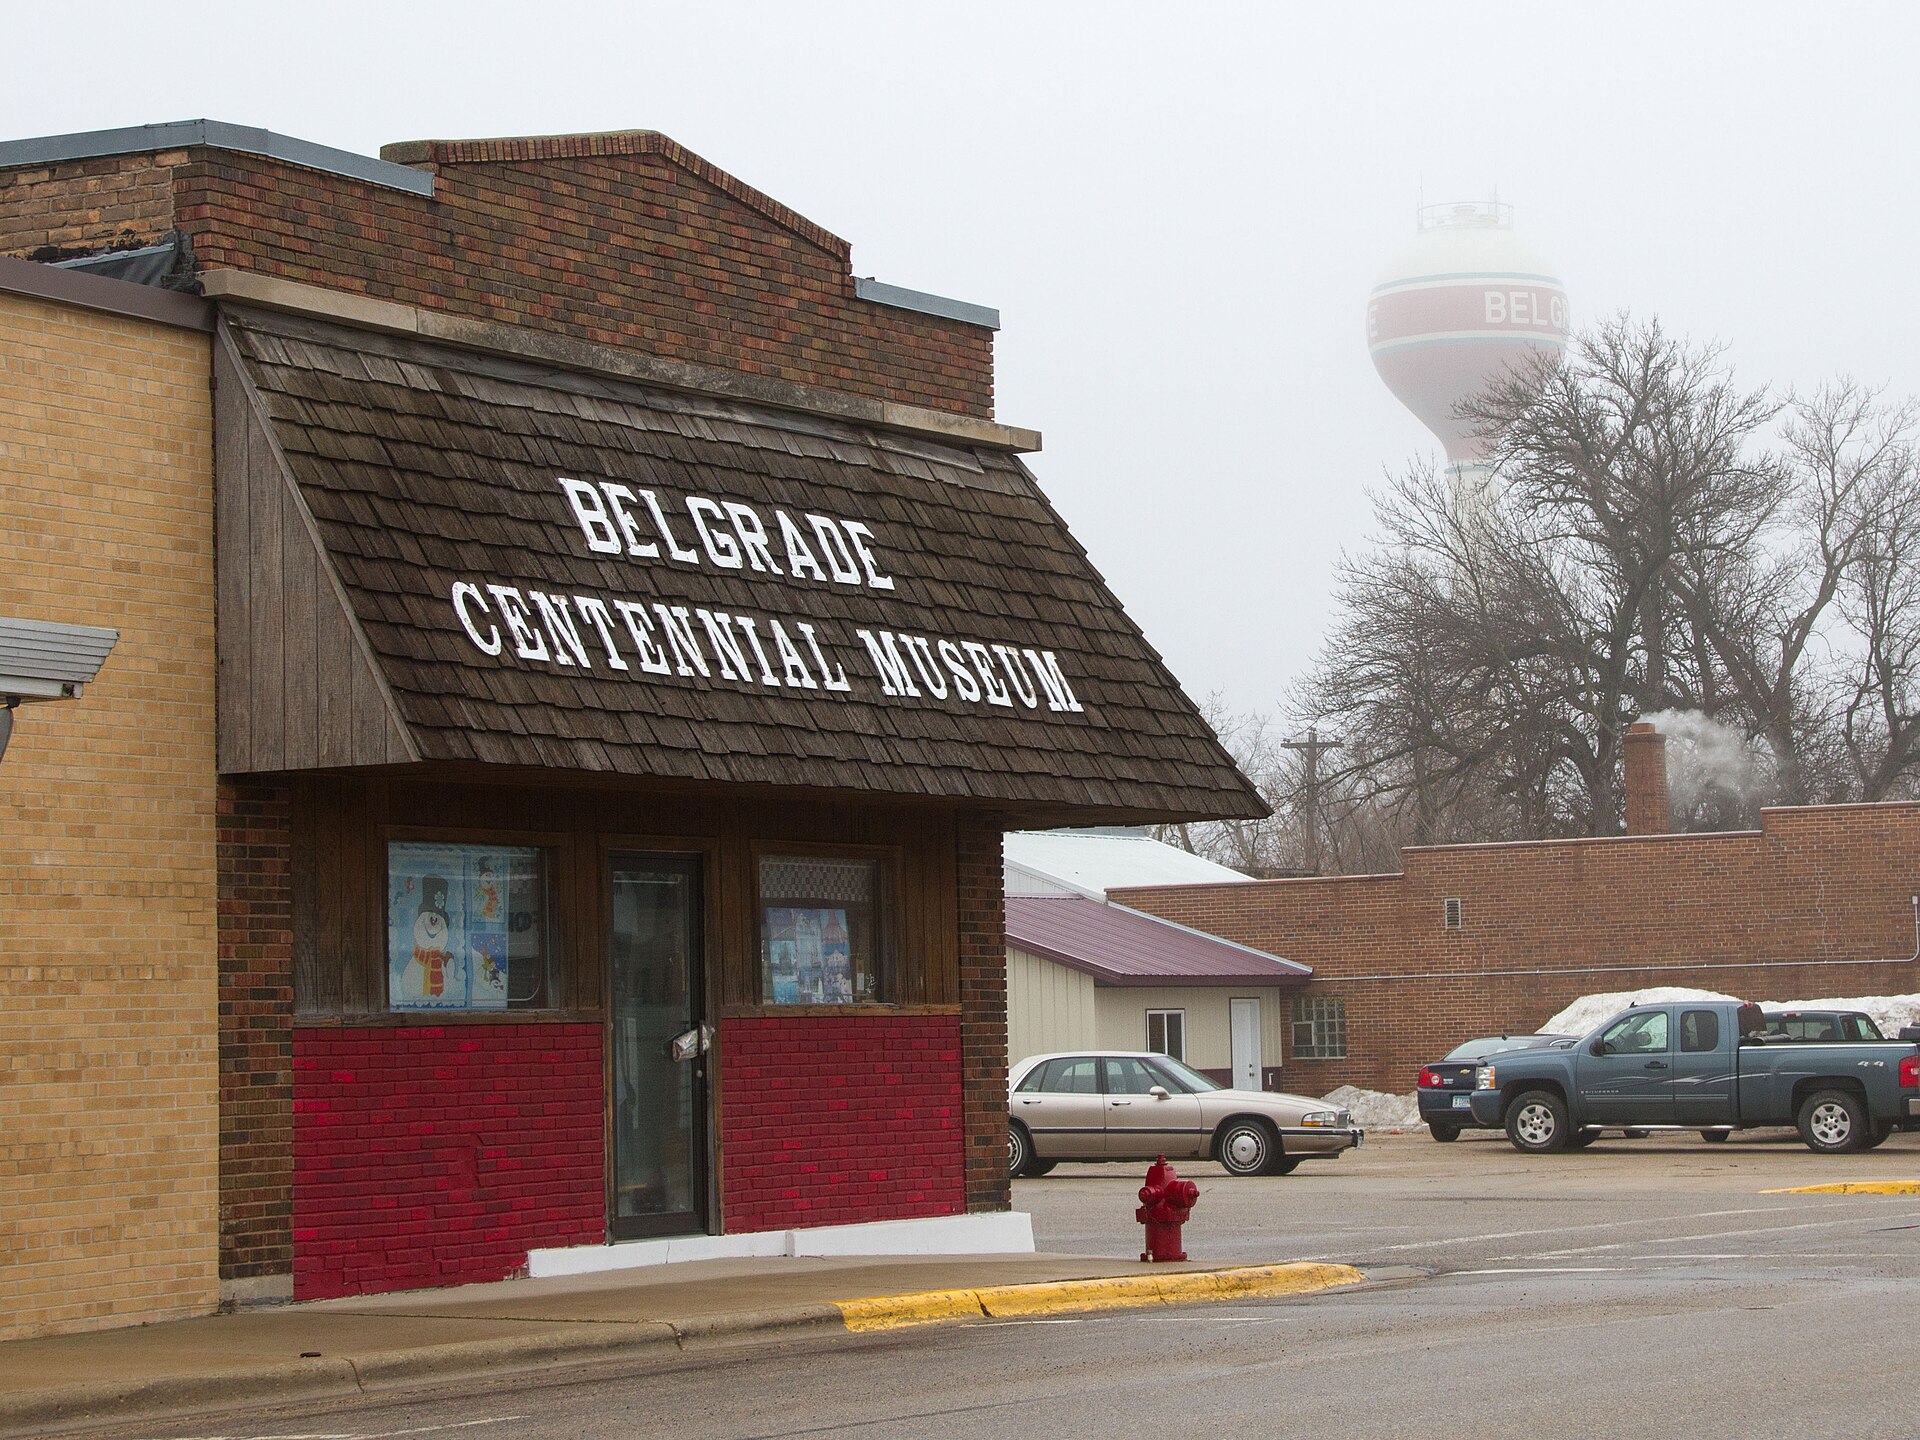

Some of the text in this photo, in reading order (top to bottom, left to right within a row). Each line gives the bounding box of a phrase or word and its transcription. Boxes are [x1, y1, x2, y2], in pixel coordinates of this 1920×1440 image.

[557, 477, 895, 591] BELGRADE
[451, 581, 1084, 712] CENTENNIAL MUSEUM
